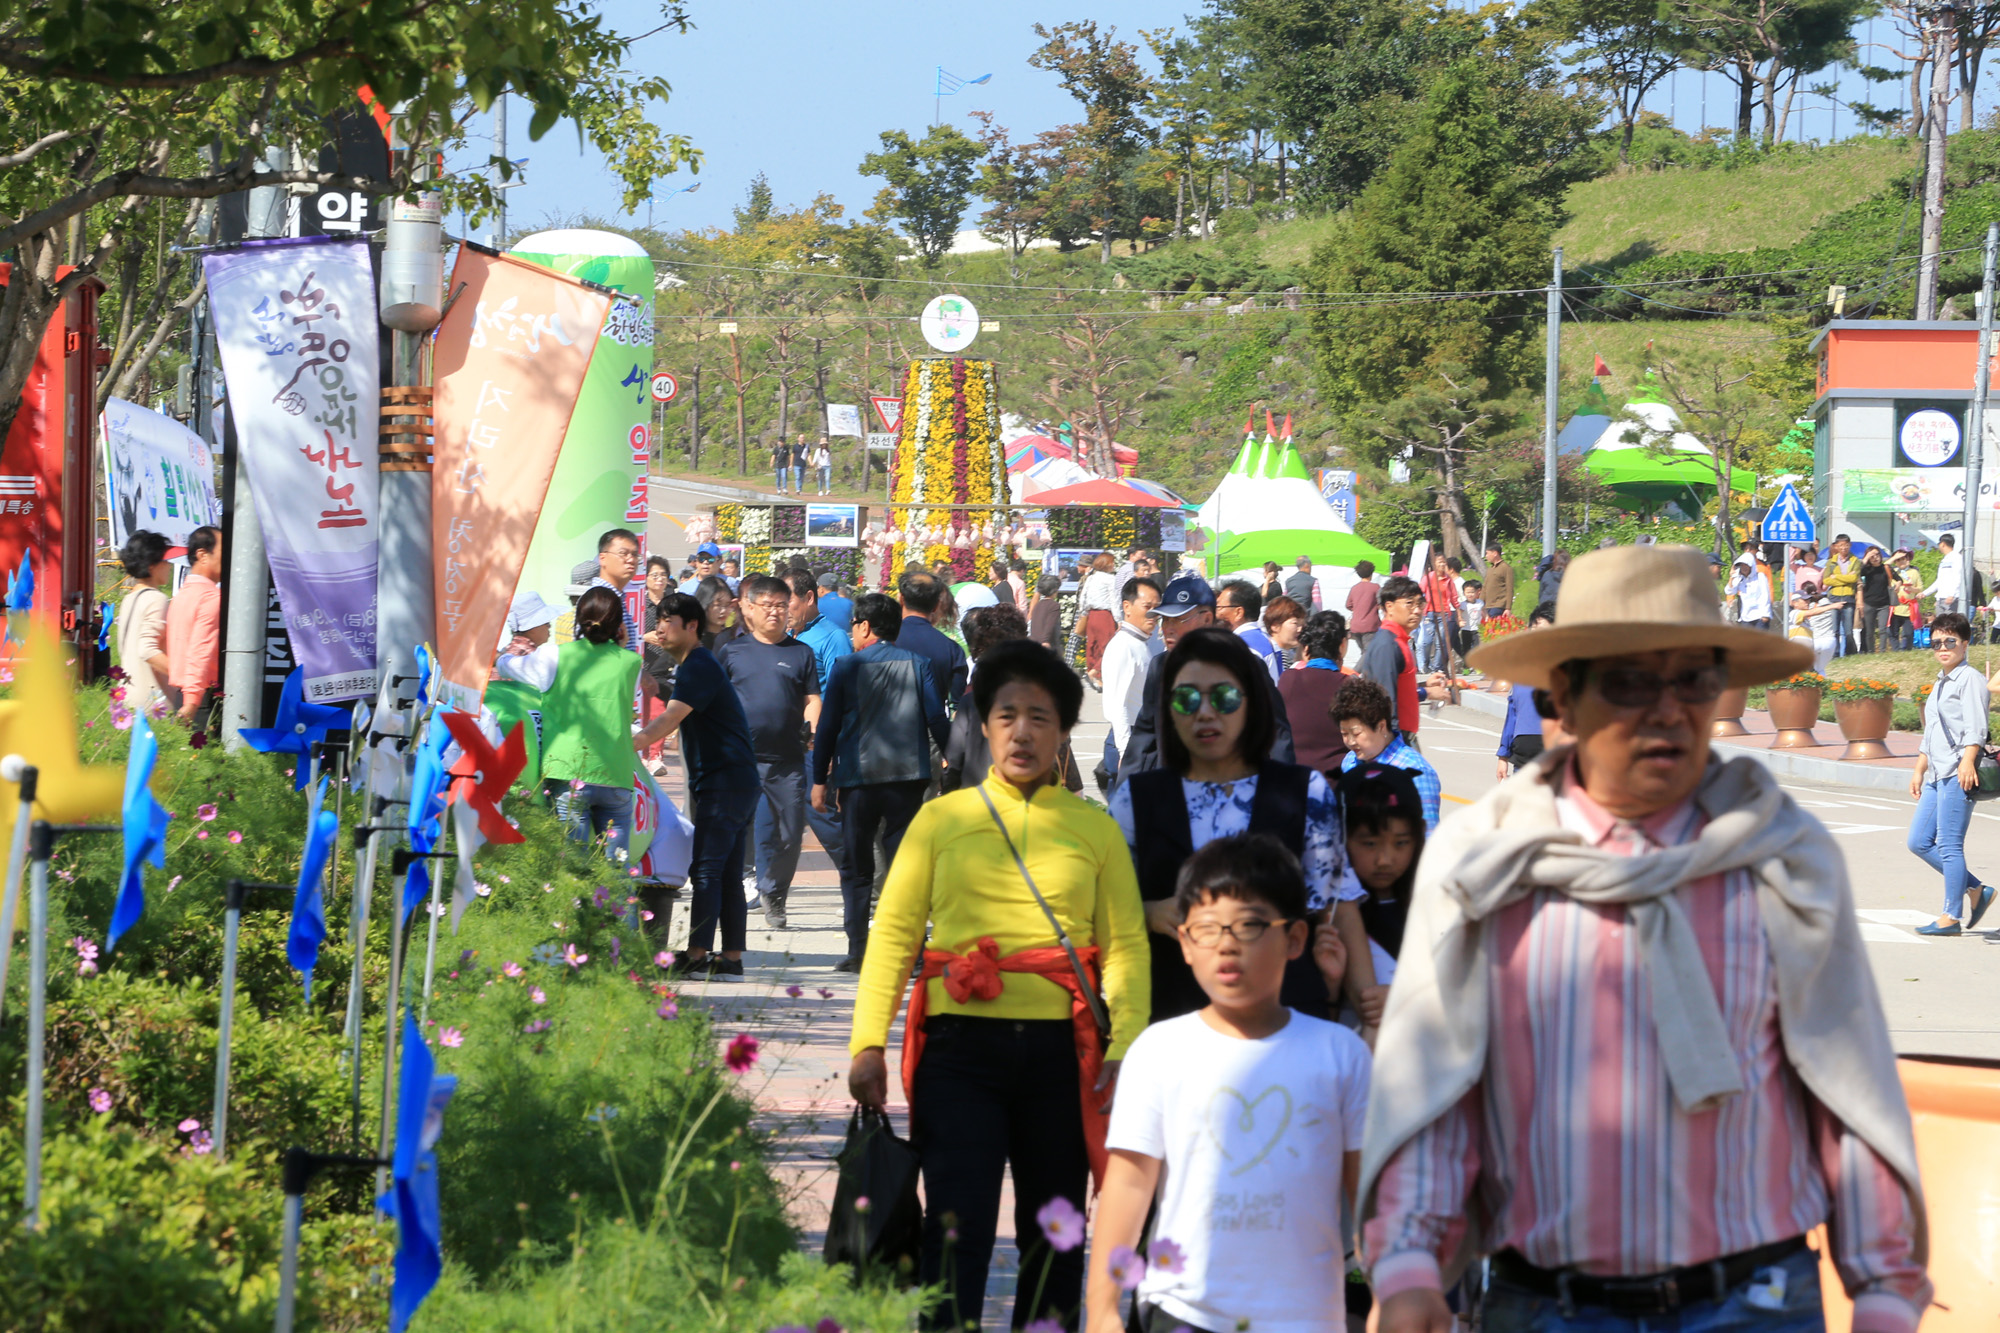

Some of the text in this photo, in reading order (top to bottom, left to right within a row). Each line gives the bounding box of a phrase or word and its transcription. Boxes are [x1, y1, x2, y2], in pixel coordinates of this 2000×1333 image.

[655, 381, 671, 394] 40
[1911, 430, 1937, 442] 자연
[1769, 531, 1808, 540] 횡단보도
